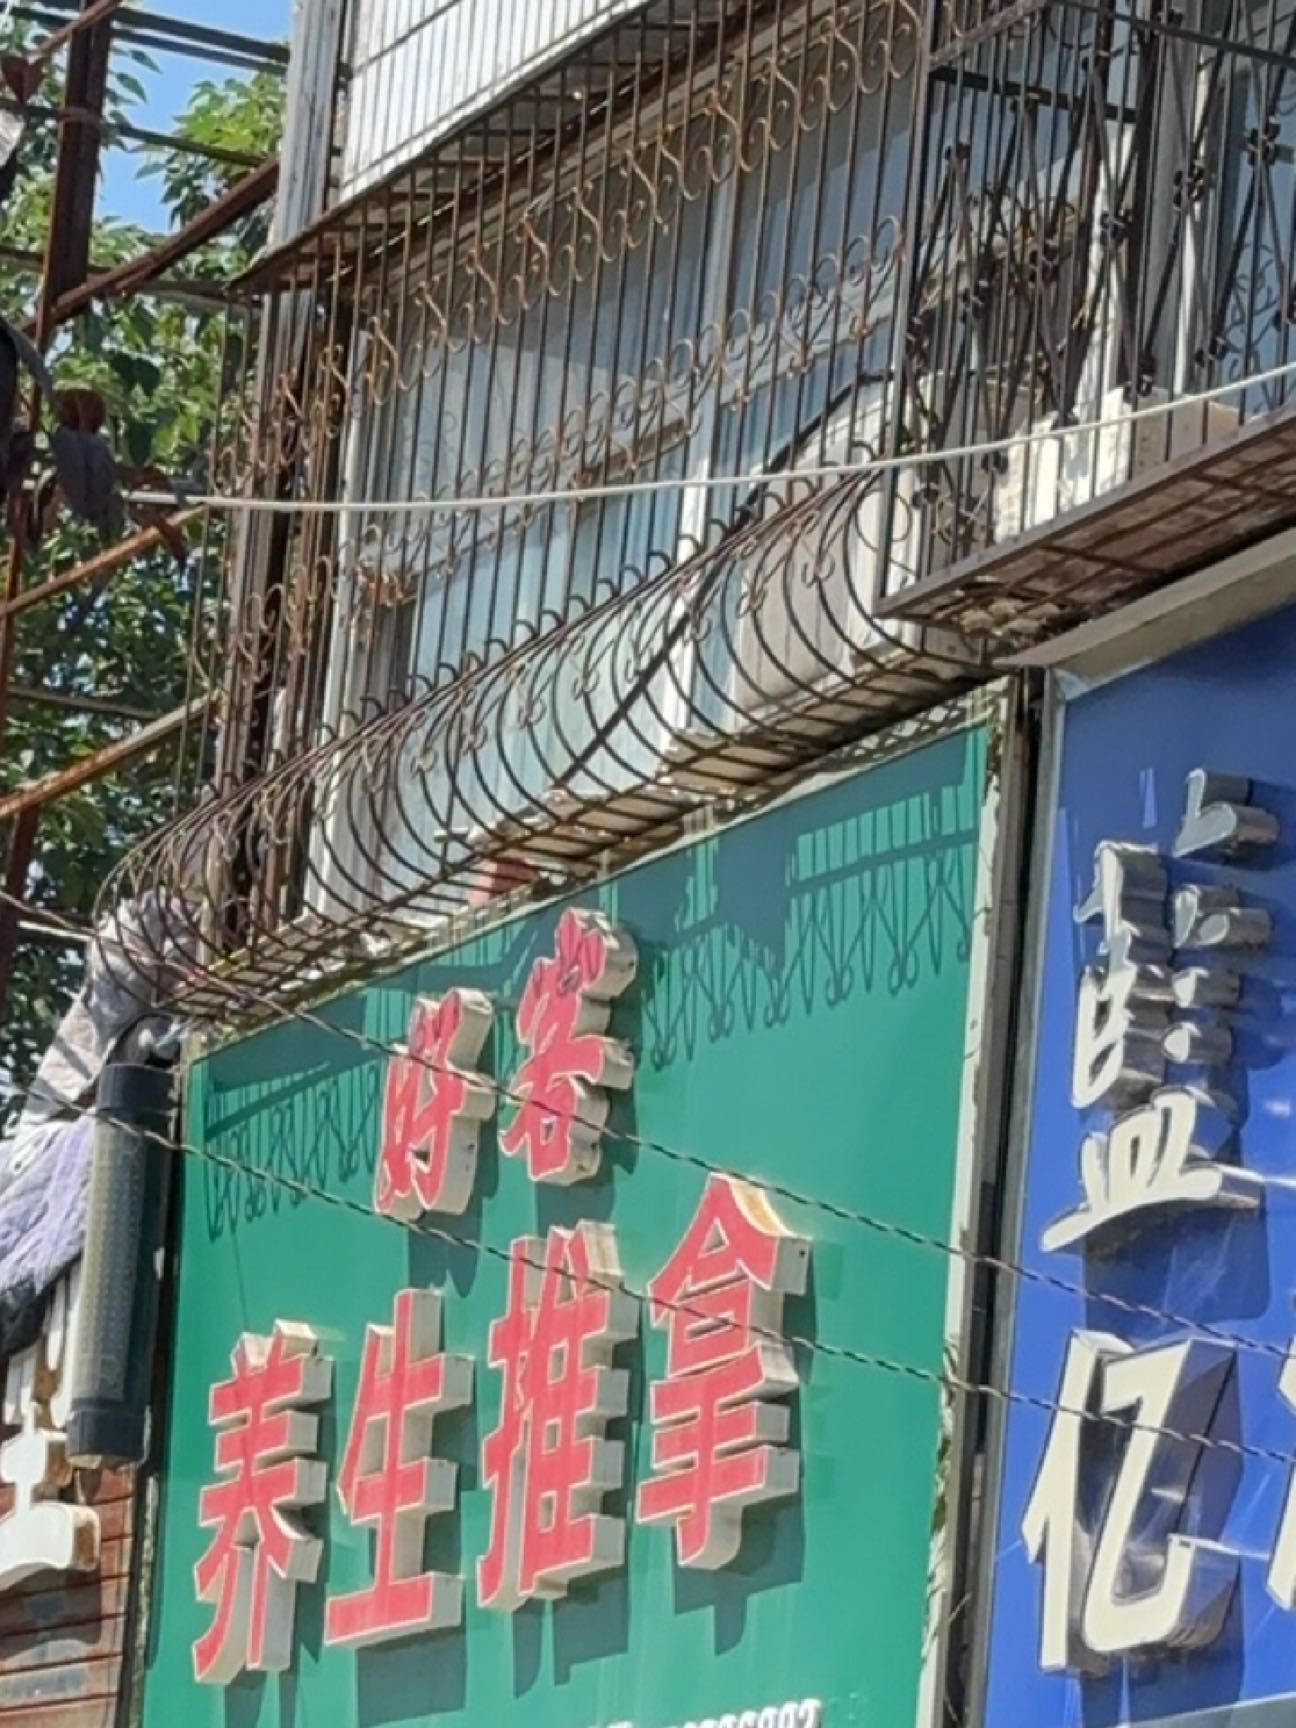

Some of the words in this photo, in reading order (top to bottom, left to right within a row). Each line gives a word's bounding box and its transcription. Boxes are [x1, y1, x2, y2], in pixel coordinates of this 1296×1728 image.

[192, 1174, 810, 1684] 养生推拿
[1021, 1328, 1296, 1670] 亿
